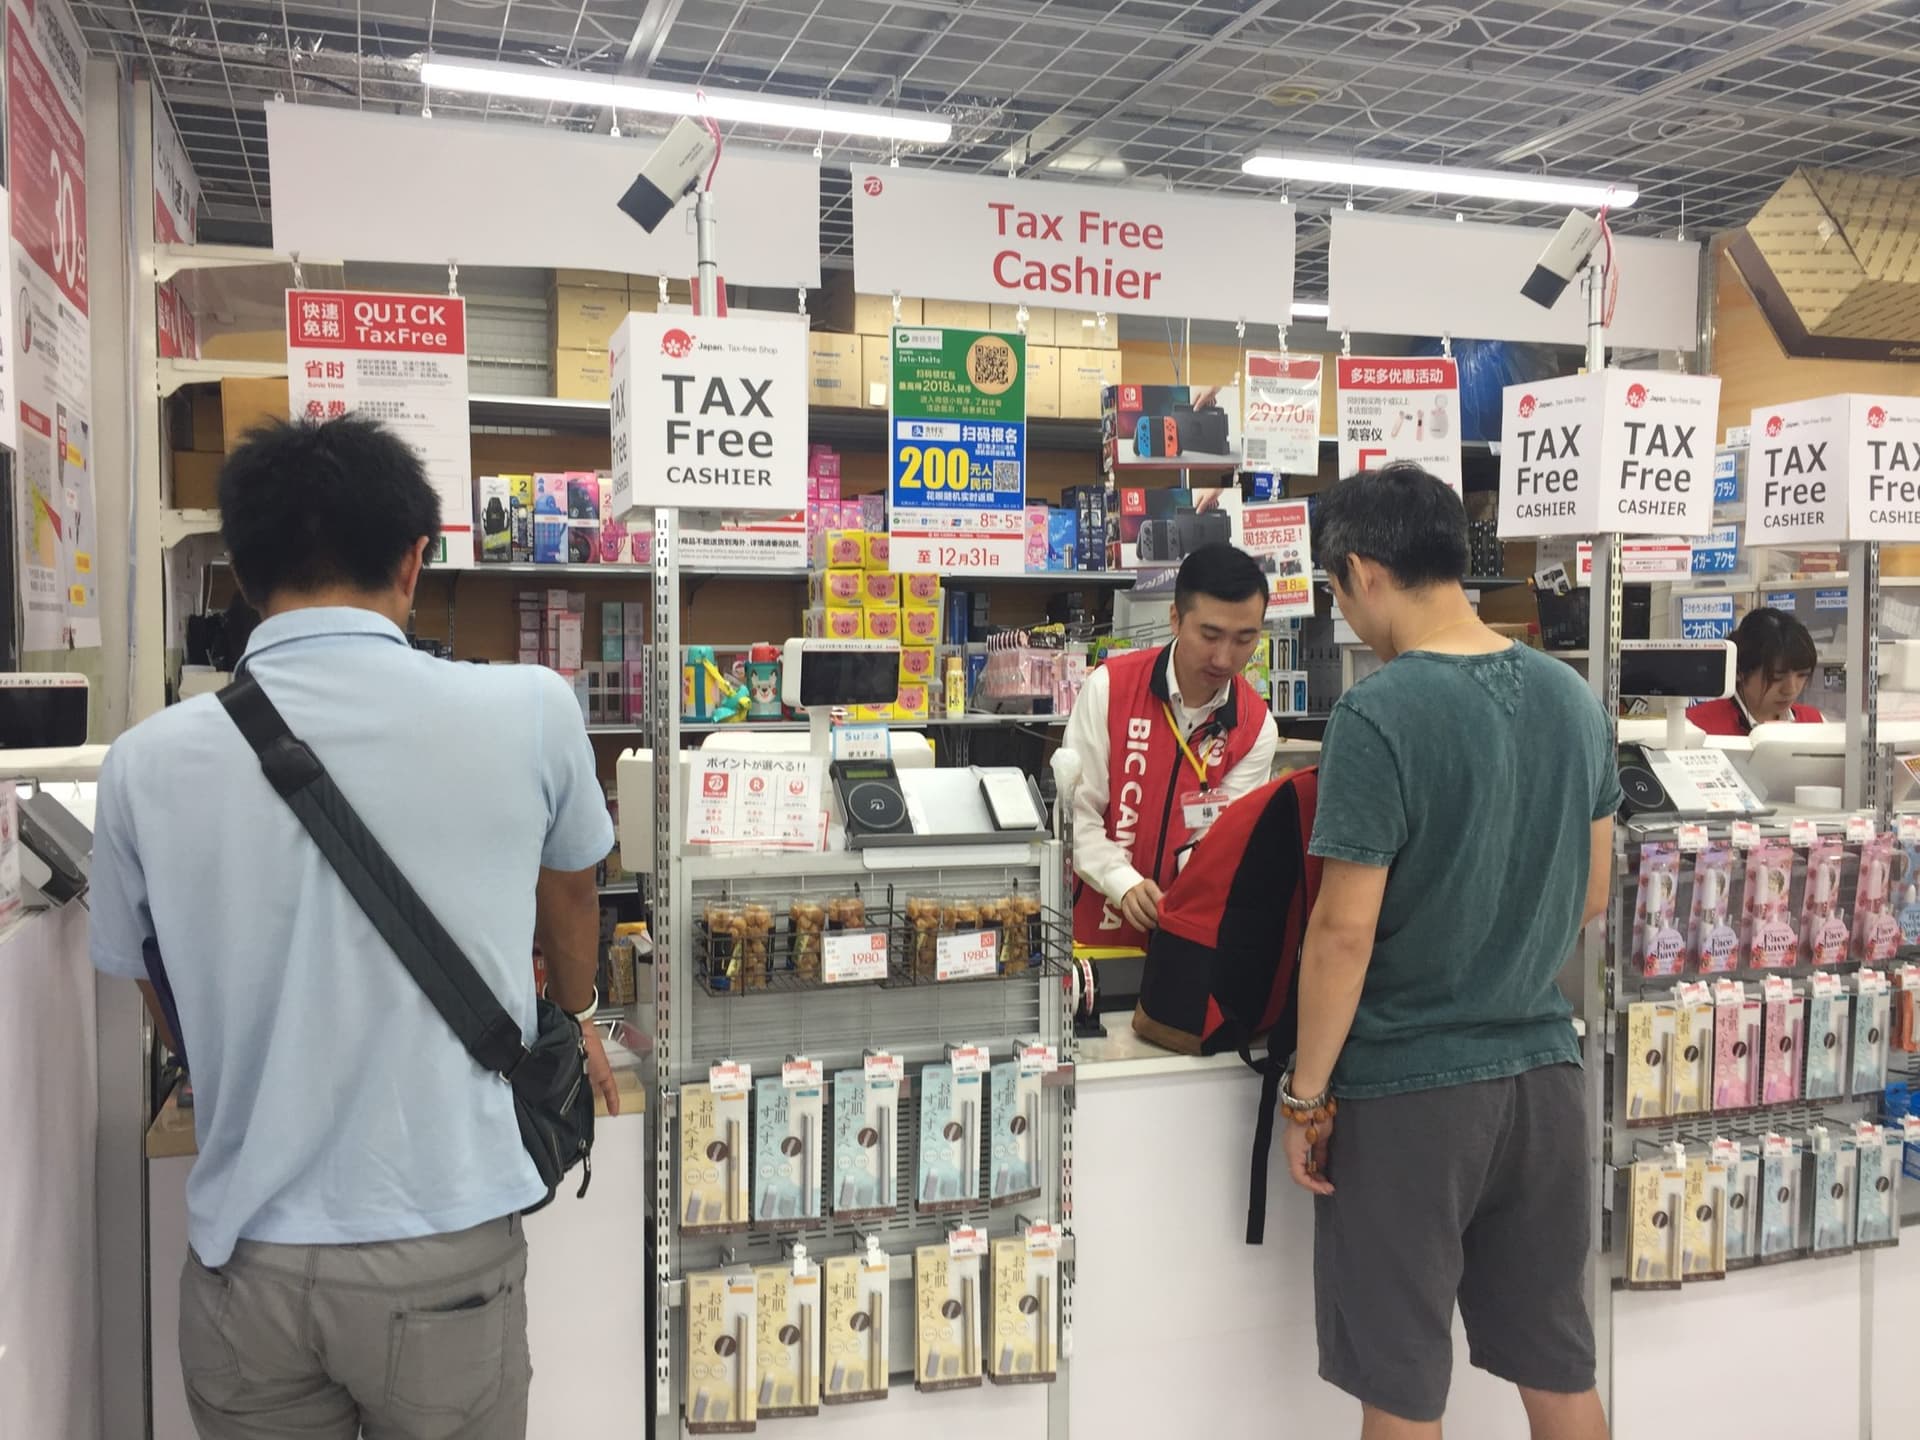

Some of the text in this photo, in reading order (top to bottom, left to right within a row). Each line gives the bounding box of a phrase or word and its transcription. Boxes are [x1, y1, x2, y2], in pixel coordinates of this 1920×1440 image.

[988, 202, 1164, 250] Tax Free
[992, 249, 1162, 300] Cashier
[303, 302, 340, 320] 快速
[353, 301, 446, 326] QUICK
[303, 319, 340, 338] 免税
[355, 326, 448, 346] TaxFree
[305, 360, 345, 379] 省时
[1351, 368, 1443, 385] 多买多优惠活动
[661, 373, 774, 418] TAX
[666, 419, 773, 459] Free
[962, 425, 1018, 443] 扫码报名
[1347, 428, 1383, 442] 美容仪
[1517, 424, 1582, 463] TAX
[1623, 421, 1697, 458] TAX
[899, 445, 969, 491] 200
[1764, 441, 1828, 478] TAX
[519, 480, 528, 493] 2
[666, 466, 772, 487] CASHIER
[1517, 466, 1579, 496] Free
[1619, 460, 1692, 493] Free
[1869, 474, 1920, 503] Fre
[1618, 499, 1687, 516] CASHIER
[1764, 480, 1826, 507] Free
[1516, 501, 1576, 518] CASHIER
[1763, 511, 1825, 528] CASHIER
[1098, 717, 1152, 931] BIC CAMA
[700, 1099, 714, 1129] お肌
[774, 1095, 789, 1124] お肌
[850, 1087, 865, 1116] お肌
[843, 1272, 857, 1300] お肌
[707, 1291, 722, 1322] お肌
